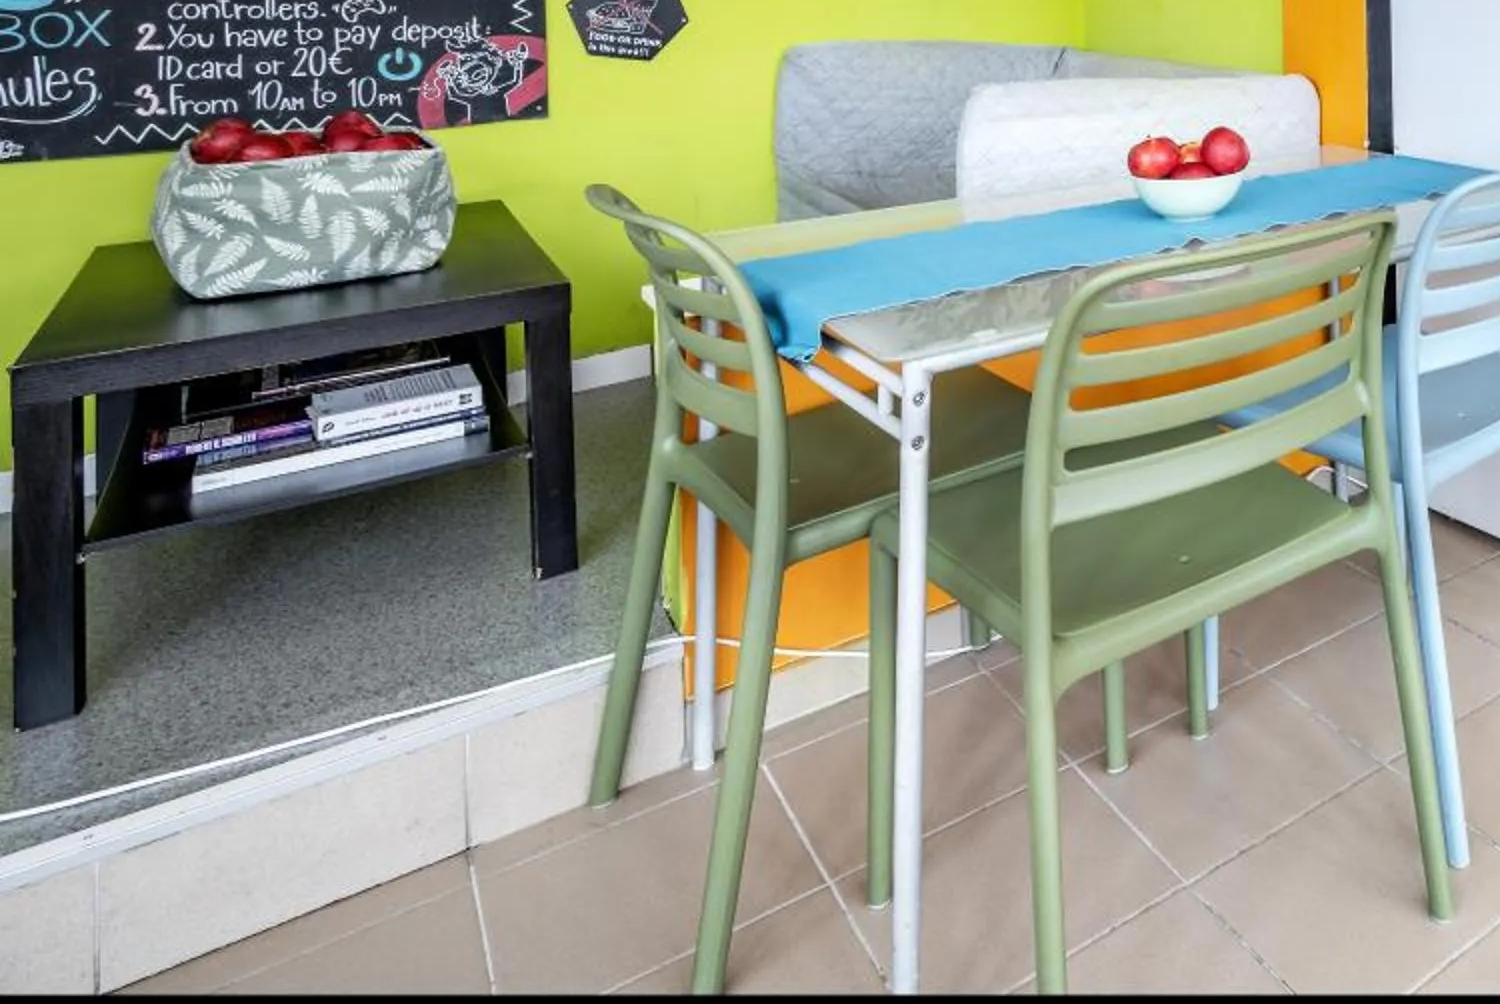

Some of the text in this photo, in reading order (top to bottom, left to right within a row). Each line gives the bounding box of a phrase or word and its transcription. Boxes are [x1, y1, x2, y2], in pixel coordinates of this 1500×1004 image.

[167, 23, 215, 49] You
[224, 21, 288, 48] have
[293, 20, 324, 46] to
[334, 25, 381, 51] pay
[0, 55, 98, 108] ules
[157, 46, 353, 81] ID card or 20€
[169, 83, 240, 116] From
[312, 79, 337, 109] to
